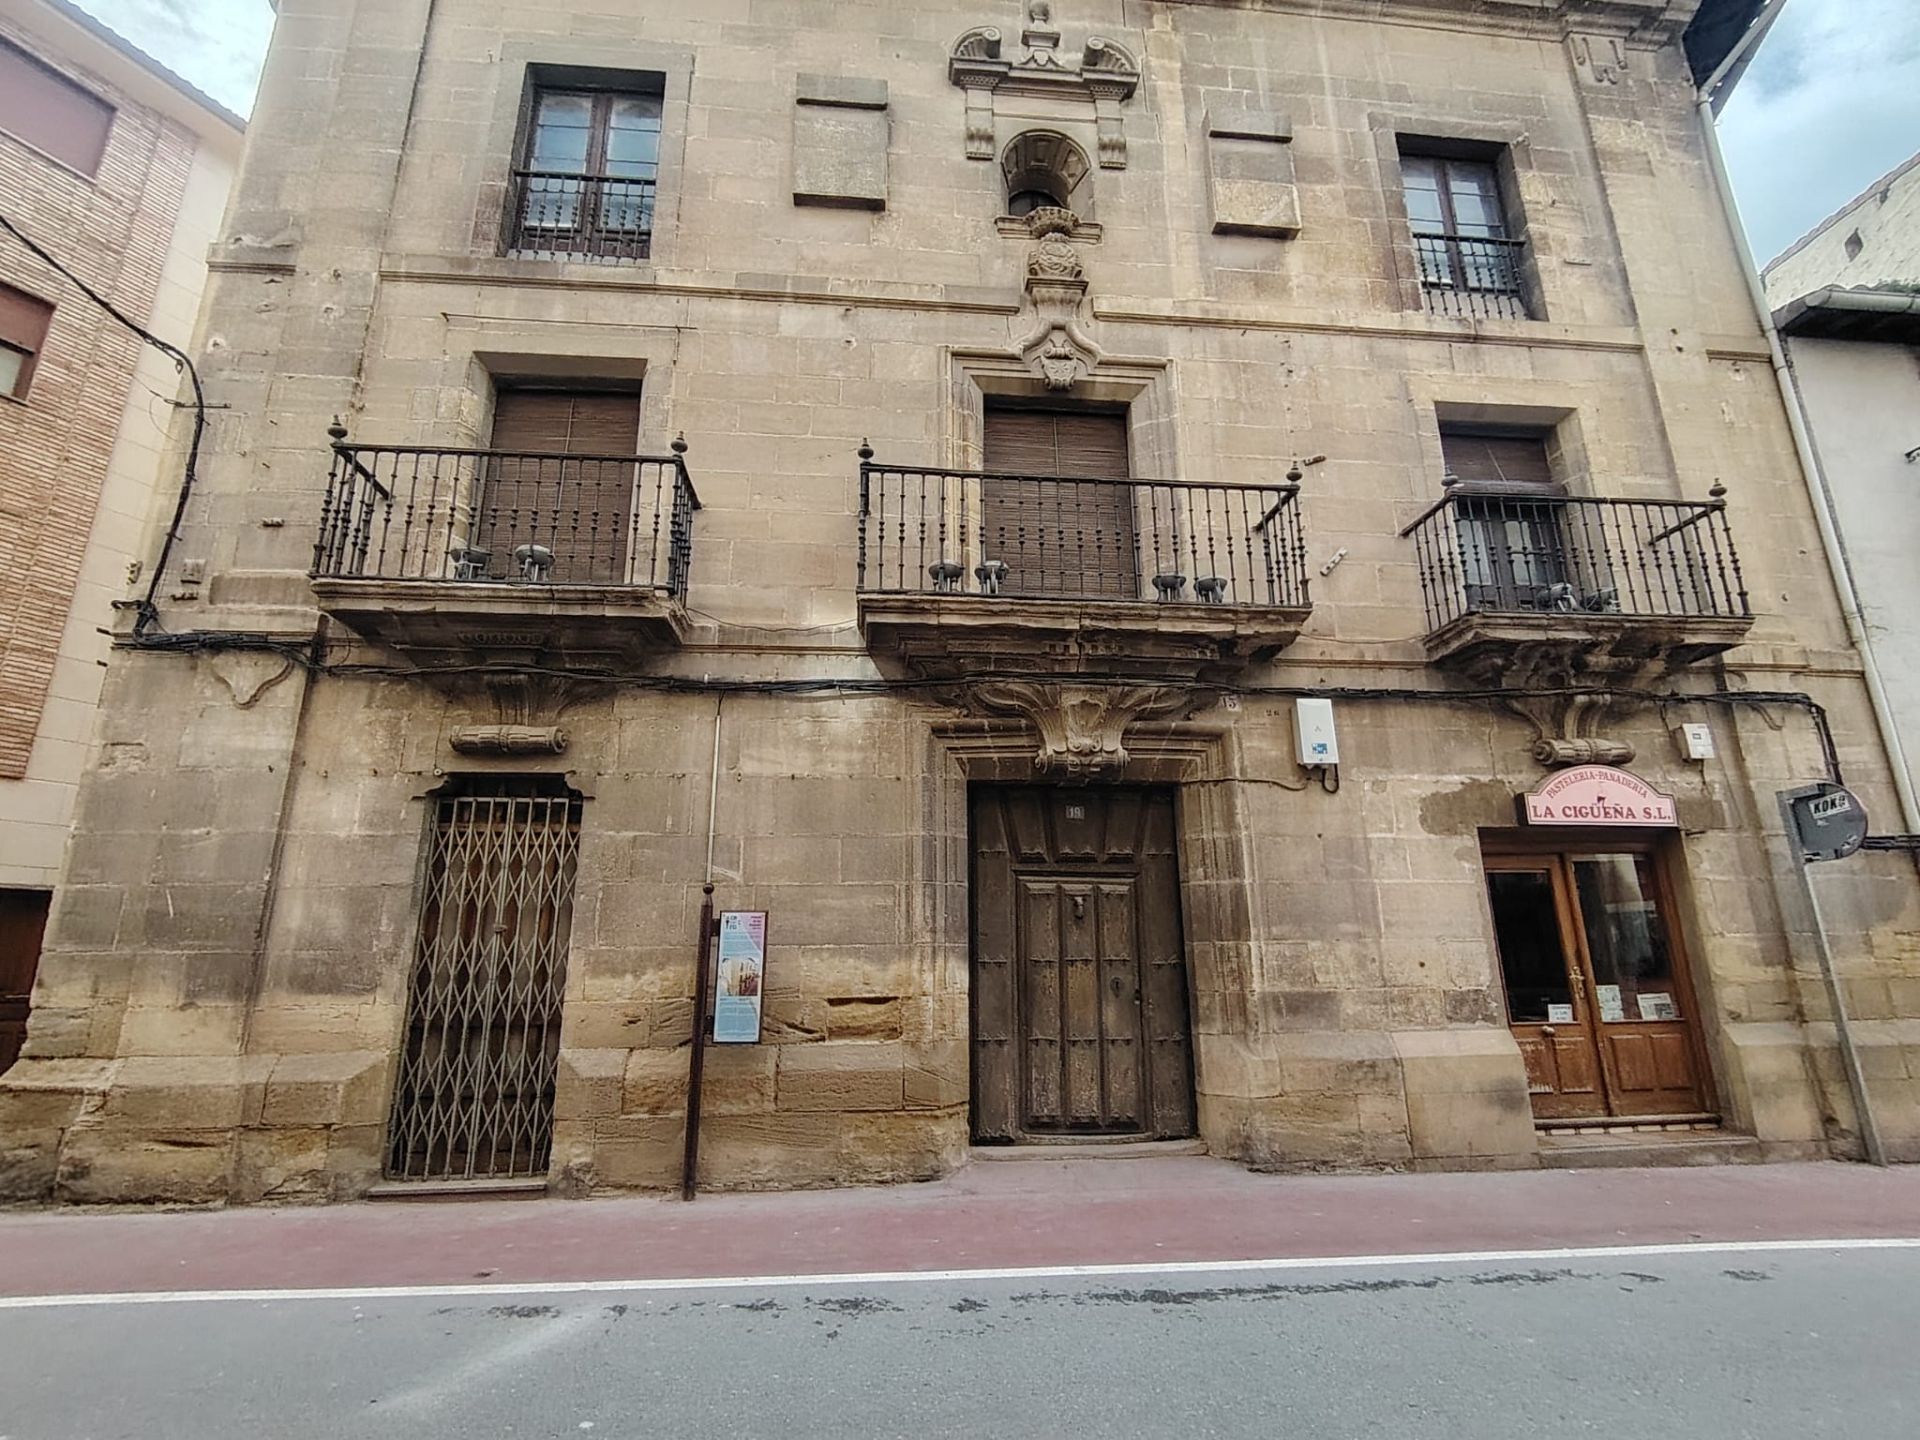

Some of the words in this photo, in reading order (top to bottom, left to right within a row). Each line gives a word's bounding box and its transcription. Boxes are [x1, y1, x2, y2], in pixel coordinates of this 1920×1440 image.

[1532, 805, 1555, 818] LA
[1562, 803, 1636, 819] CIGÜEÑA
[1643, 807, 1671, 820] S.L.
